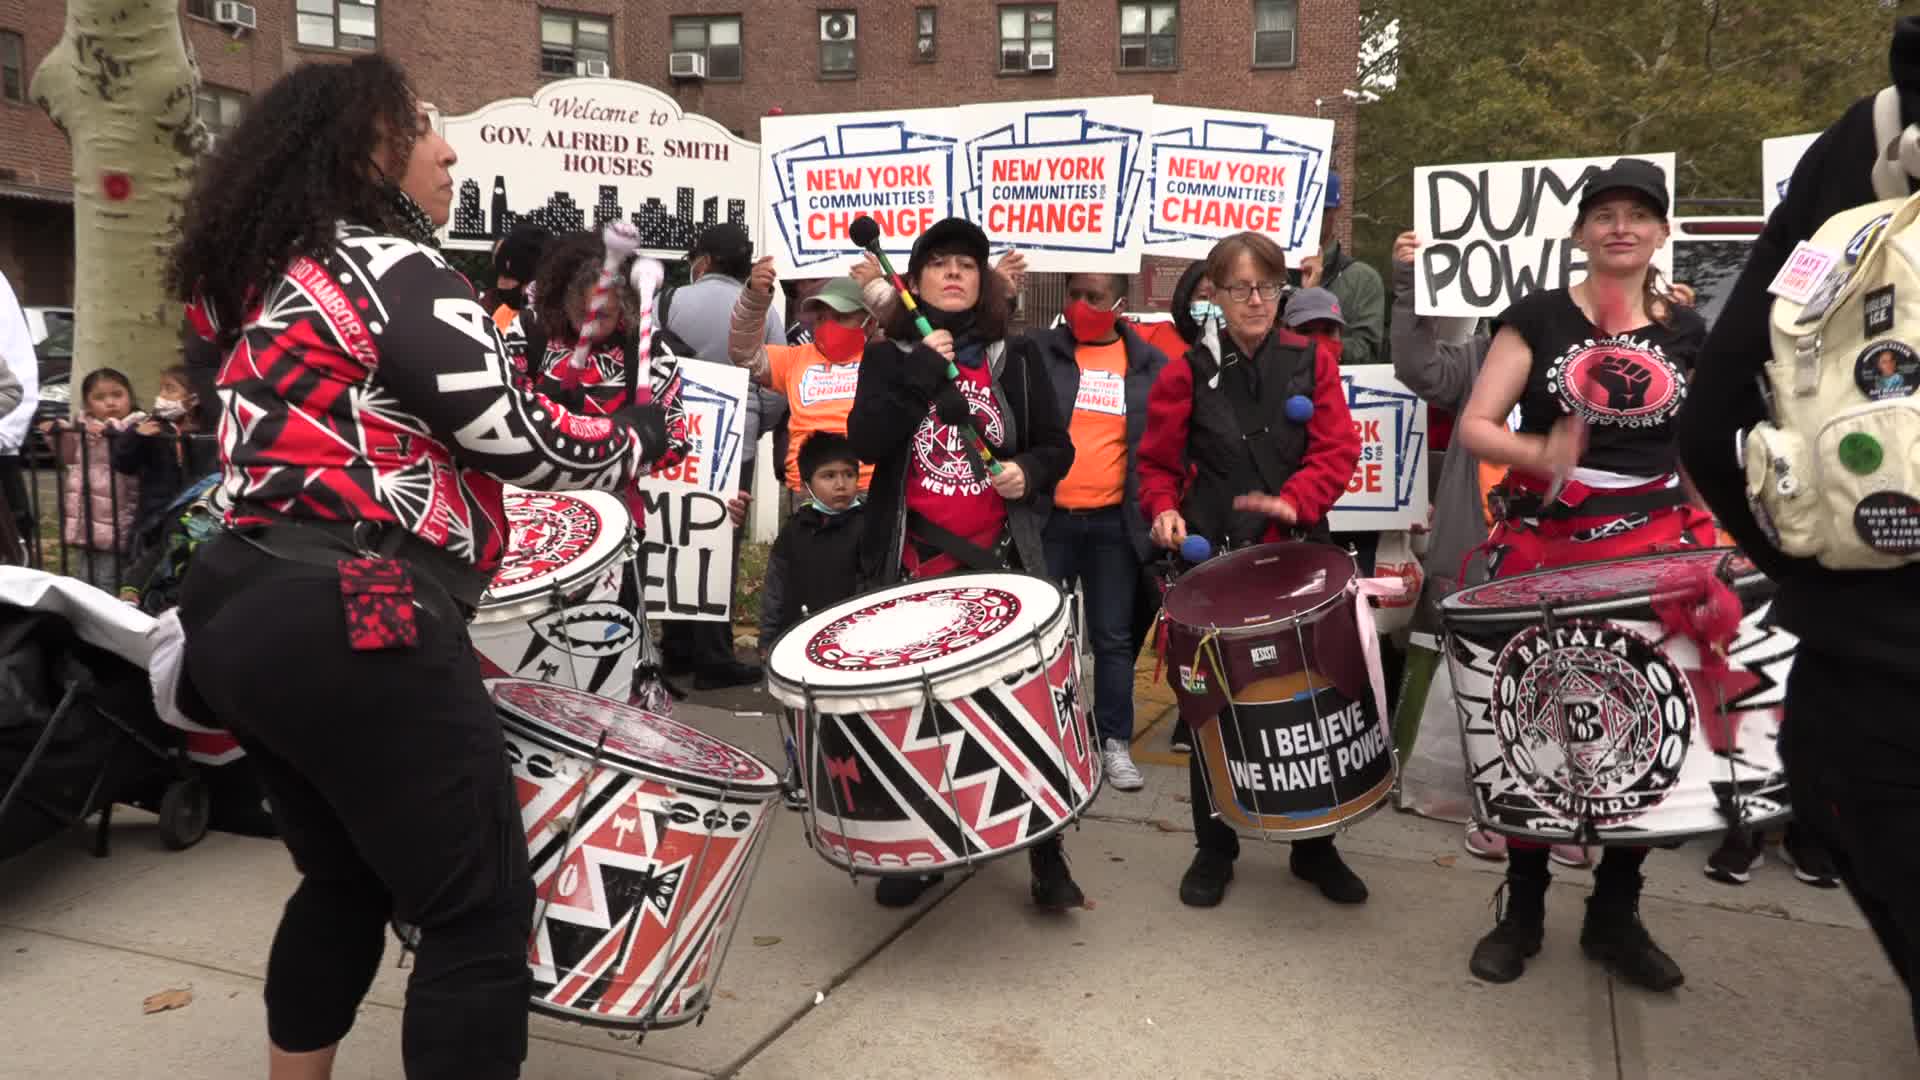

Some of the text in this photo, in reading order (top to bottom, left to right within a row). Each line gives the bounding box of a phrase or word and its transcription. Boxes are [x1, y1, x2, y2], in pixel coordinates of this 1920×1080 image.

[550, 98, 669, 126] Welcome to
[479, 124, 730, 162] GOV. ALFRED E. SMITH
[563, 153, 654, 177] HOUSES
[806, 163, 932, 192] NEW YORK
[991, 156, 1105, 183] NEW YORK
[1168, 156, 1285, 187] NEW YORK
[808, 190, 926, 209] COMMUNITIES
[992, 183, 1098, 201] COMMUNITIES
[1166, 180, 1276, 203] COMMUNITIES
[1428, 166, 1598, 242] DUM
[807, 207, 935, 241] CHNGE
[988, 203, 1103, 233] CHANGE
[1161, 197, 1283, 233] CHANGE
[1422, 237, 1590, 309] POWE
[304, 269, 362, 339] TAMBOR
[1077, 391, 1120, 408] ANGE
[1617, 413, 1665, 428] YORK
[921, 476, 957, 497] NEW
[637, 489, 728, 547] MP
[638, 541, 728, 617] ELL
[1517, 629, 1629, 664] BATALA
[1260, 700, 1366, 758] I BELIEVE
[1229, 722, 1388, 792] WE HAVE POWE
[1556, 794, 1640, 815] MUNDO
